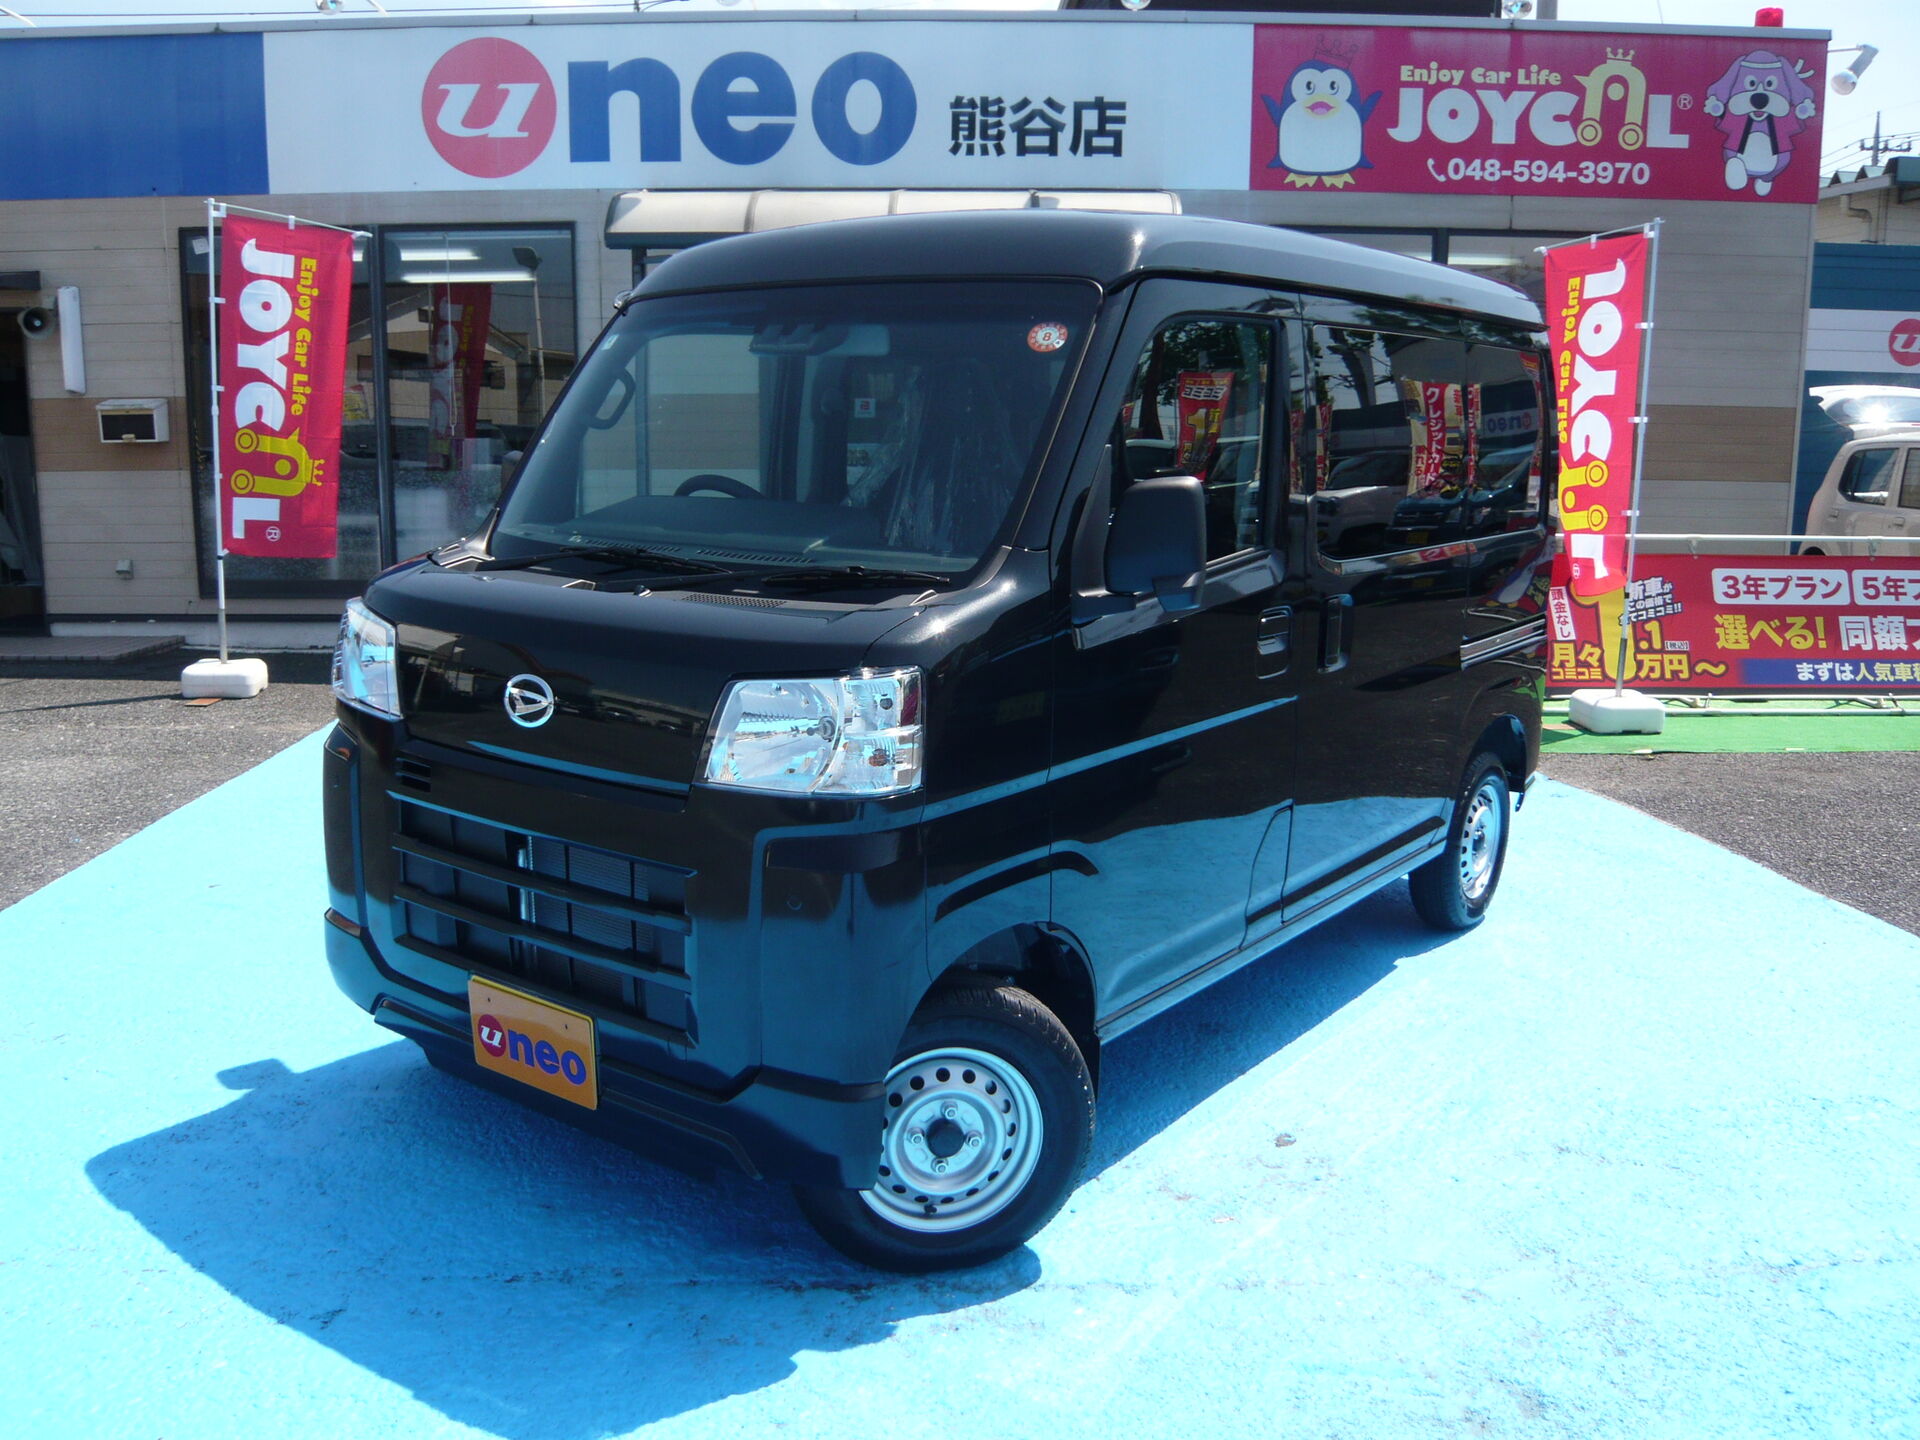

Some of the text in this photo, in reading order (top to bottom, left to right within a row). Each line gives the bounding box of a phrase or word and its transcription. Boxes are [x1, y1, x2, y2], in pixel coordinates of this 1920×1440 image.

[1400, 61, 1561, 86] Enjoy Car Life
[948, 95, 1127, 157] 熊谷店
[1447, 157, 1650, 185] 048-594-3970
[290, 257, 318, 415] Enjoy Car Life
[1721, 575, 1842, 600] 3年プラン
[1550, 588, 1572, 638] 頭金なし
[1714, 614, 1827, 650] 選べる!
[1552, 642, 1602, 668] 月々
[1552, 668, 1602, 680] コミコミ
[479, 1020, 587, 1086] uneo
